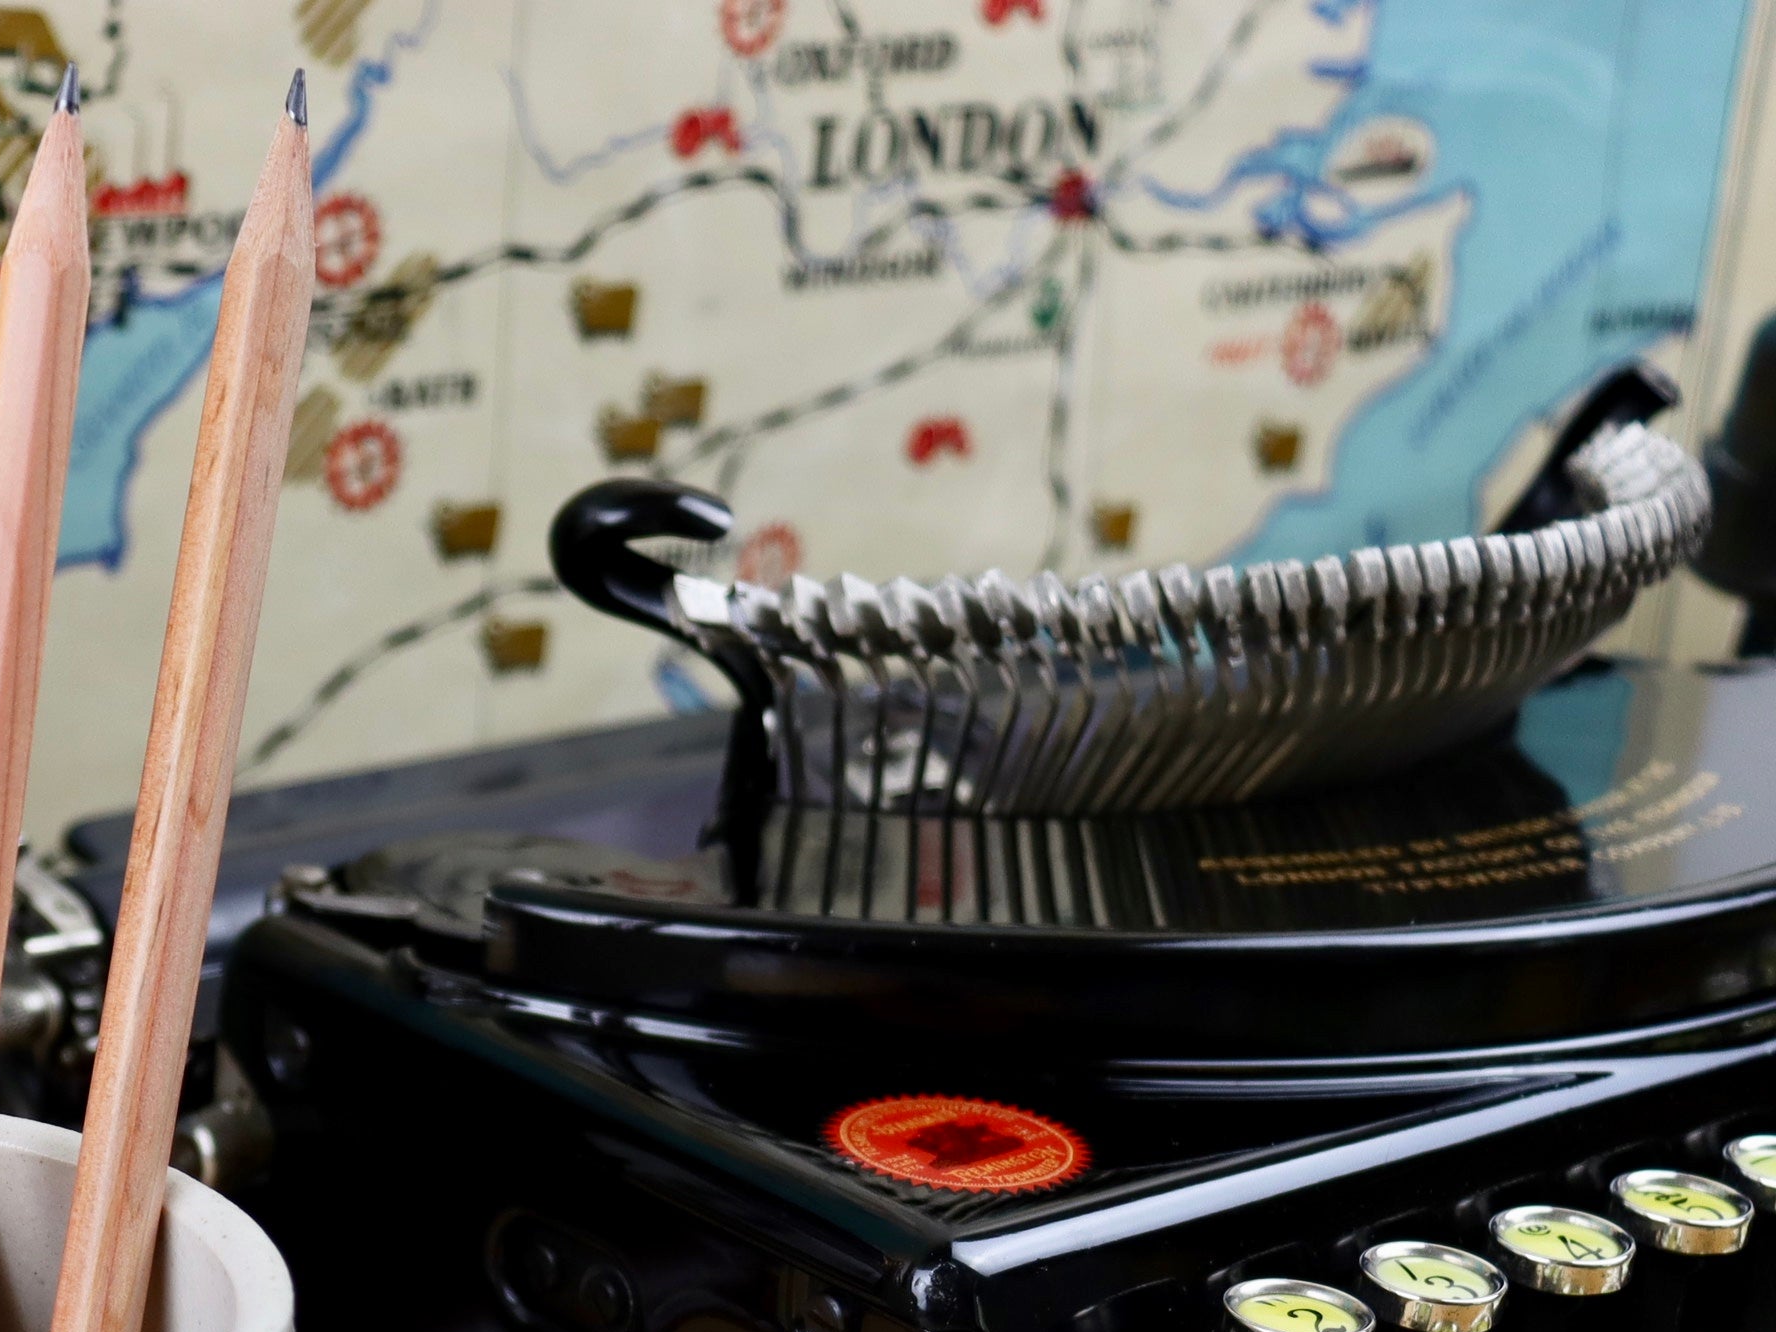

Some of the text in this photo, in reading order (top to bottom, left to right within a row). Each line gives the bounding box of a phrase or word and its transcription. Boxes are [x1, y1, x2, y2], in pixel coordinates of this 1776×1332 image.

[807, 97, 1103, 189] LONDON
[1556, 1235, 1607, 1260] 4
[1424, 1275, 1479, 1299] 3
